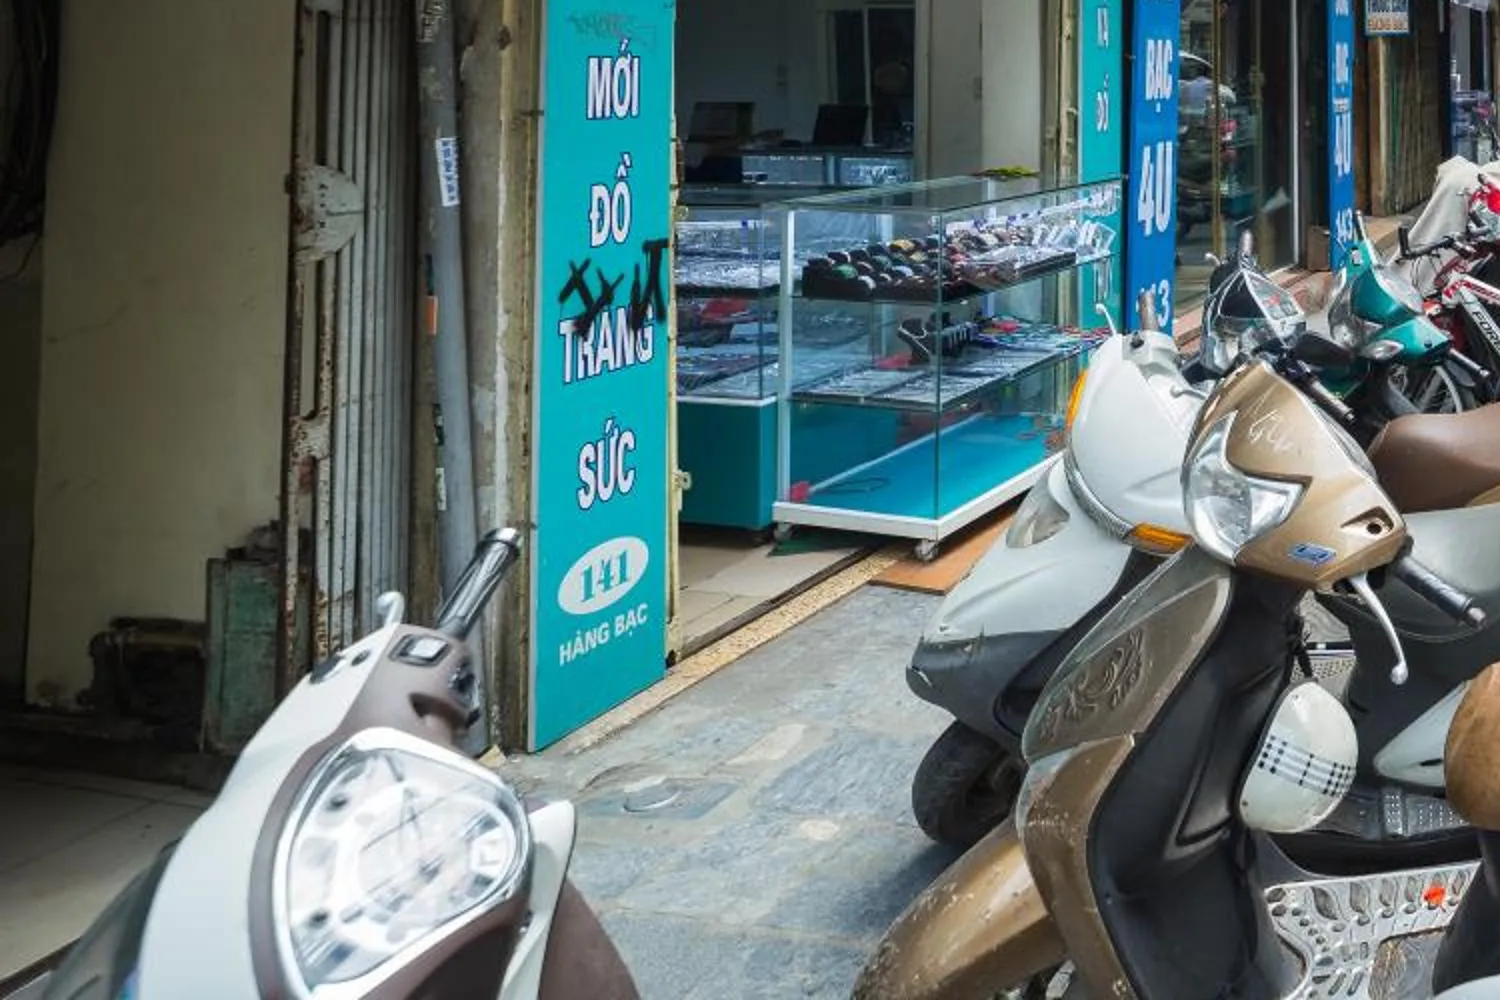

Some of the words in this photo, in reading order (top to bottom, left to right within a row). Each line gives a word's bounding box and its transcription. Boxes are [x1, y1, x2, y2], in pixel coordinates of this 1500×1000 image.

[586, 38, 641, 120] MỚI
[1145, 39, 1174, 112] BẠC
[558, 303, 654, 385] TRANG
[577, 418, 637, 510] SỨC
[581, 551, 628, 602] 141
[560, 621, 609, 666] HÀNG
[614, 602, 648, 637] BẠC
